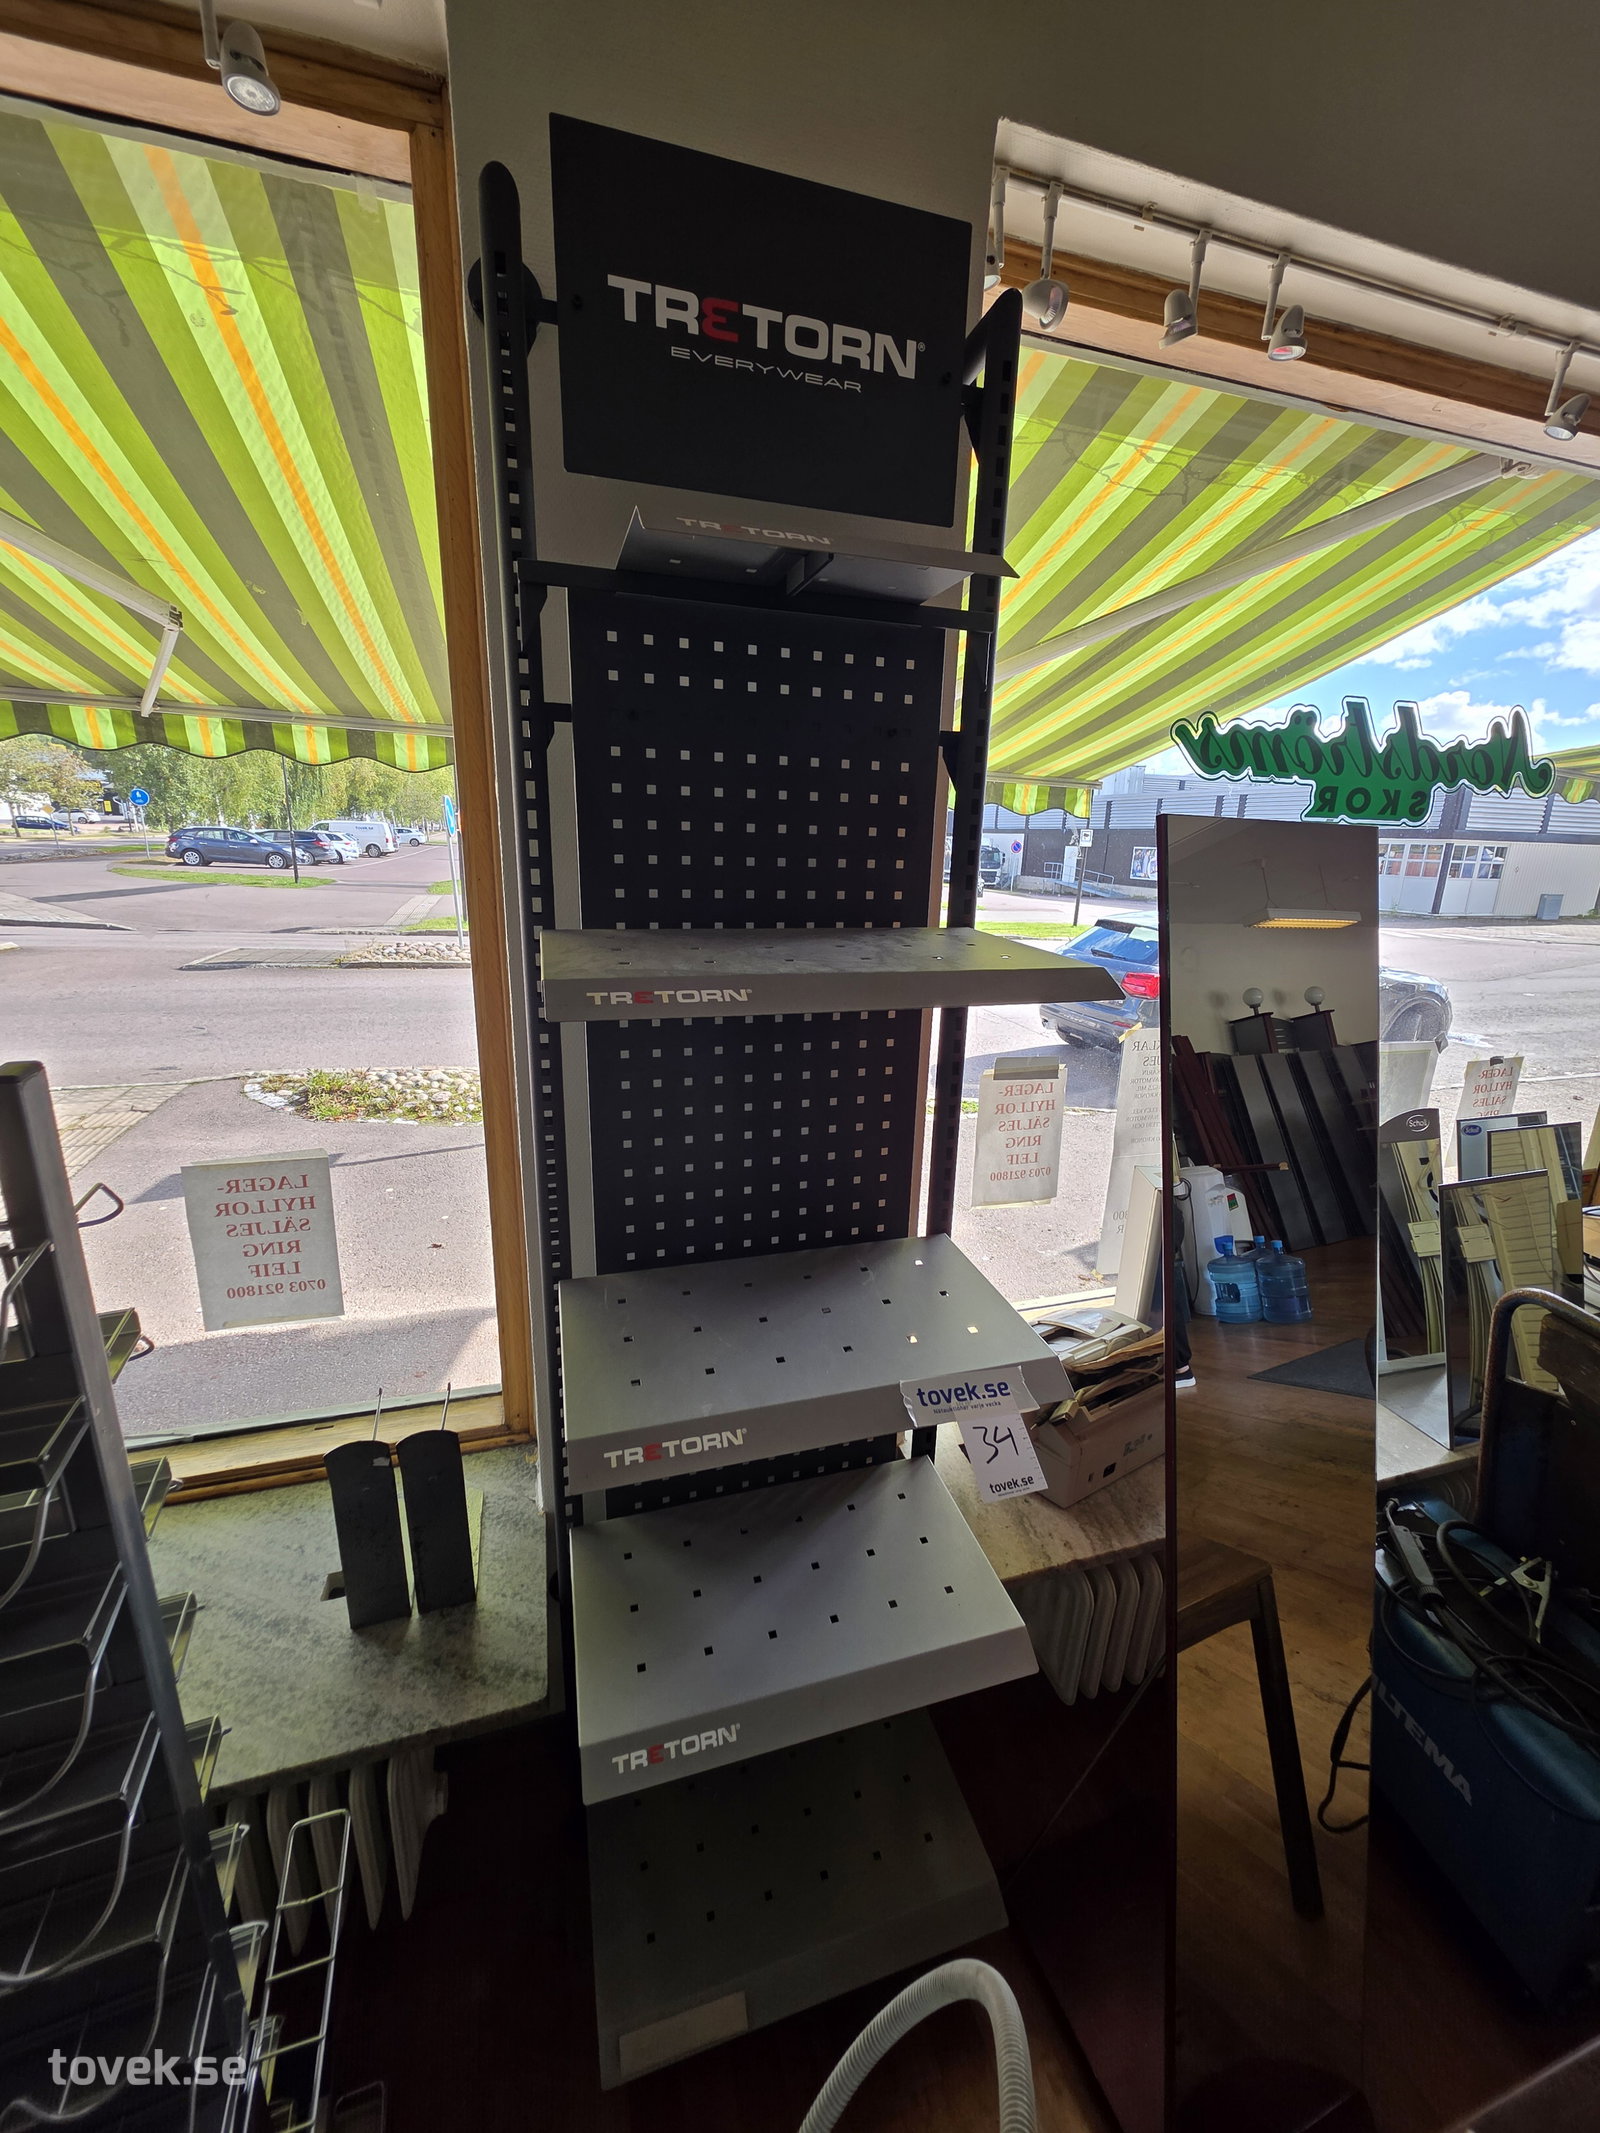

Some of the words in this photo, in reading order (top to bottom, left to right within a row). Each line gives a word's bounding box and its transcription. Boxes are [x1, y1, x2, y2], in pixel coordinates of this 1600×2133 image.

[670, 345, 862, 394] EVERYWEAR
[916, 1381, 1011, 1407] tovek.se
[972, 1425, 1019, 1464] 34
[989, 1475, 1035, 1494] tovek.se
